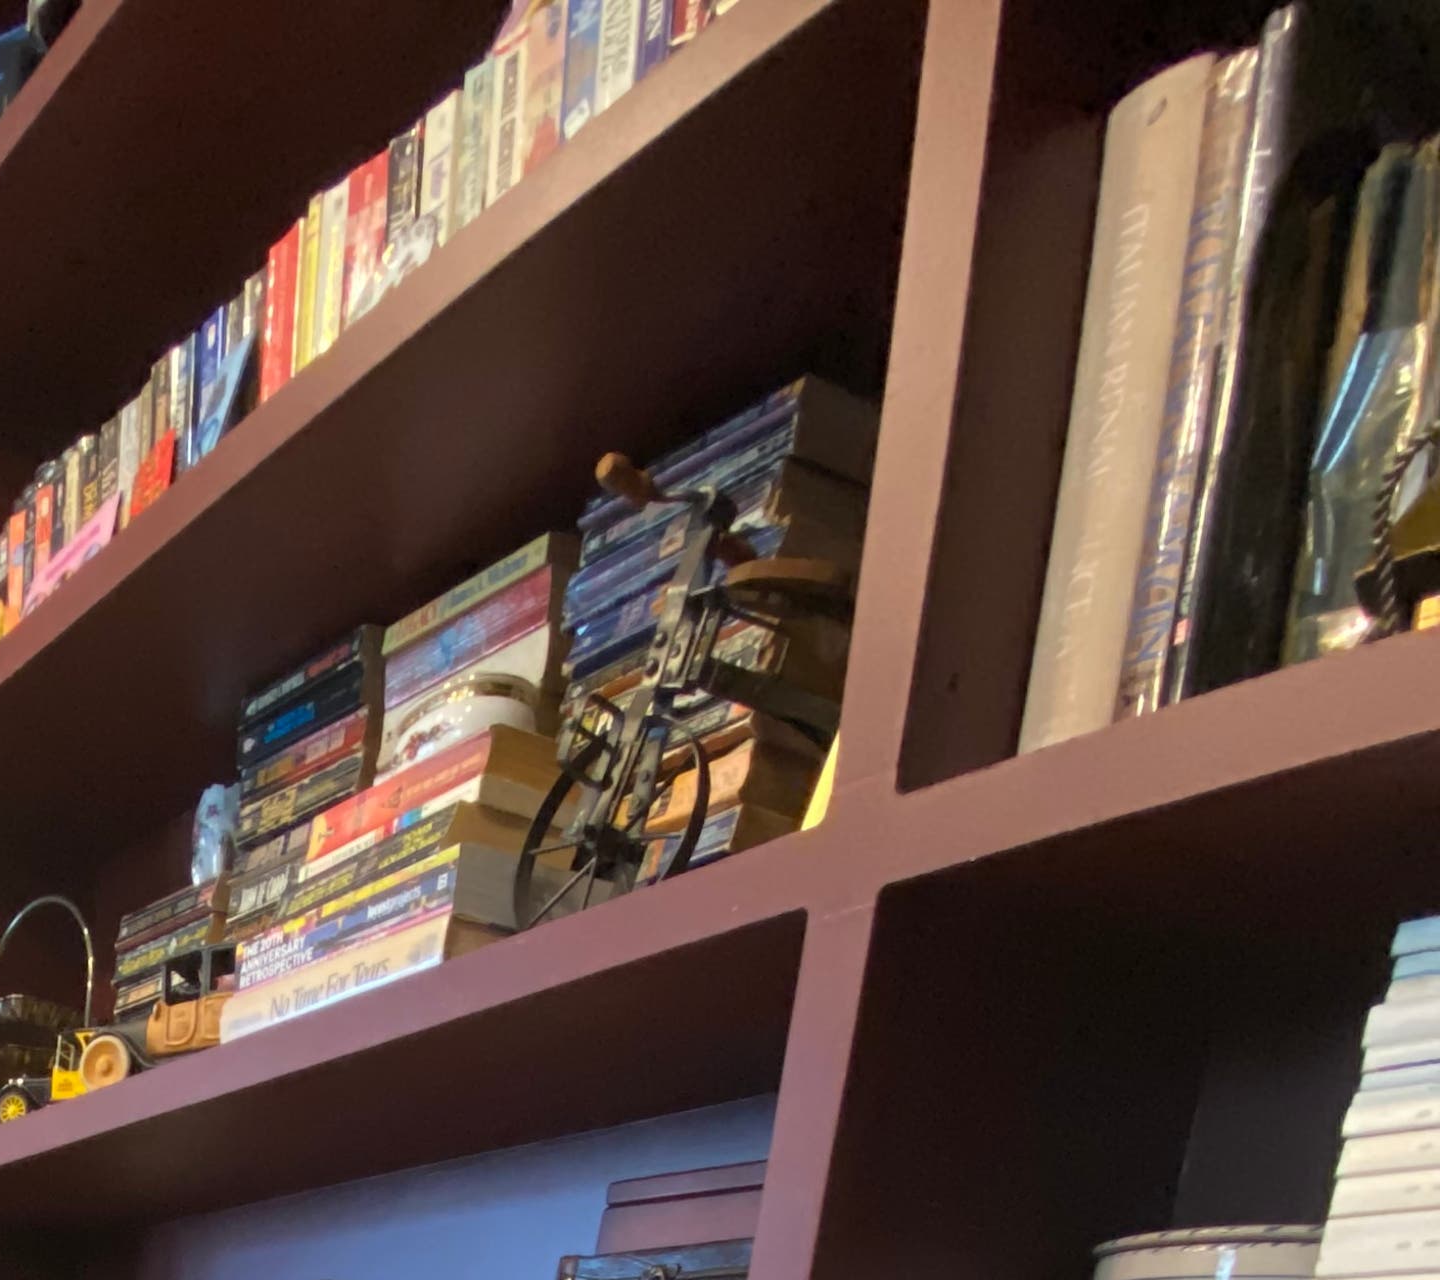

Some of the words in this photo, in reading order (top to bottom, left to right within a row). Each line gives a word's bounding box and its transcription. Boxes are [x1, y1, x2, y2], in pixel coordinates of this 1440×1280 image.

[240, 936, 306, 974] ANNIVERSARY
[242, 940, 261, 958] THE
[239, 947, 315, 988] RETROSPECTIVE
[270, 995, 290, 1019] No
